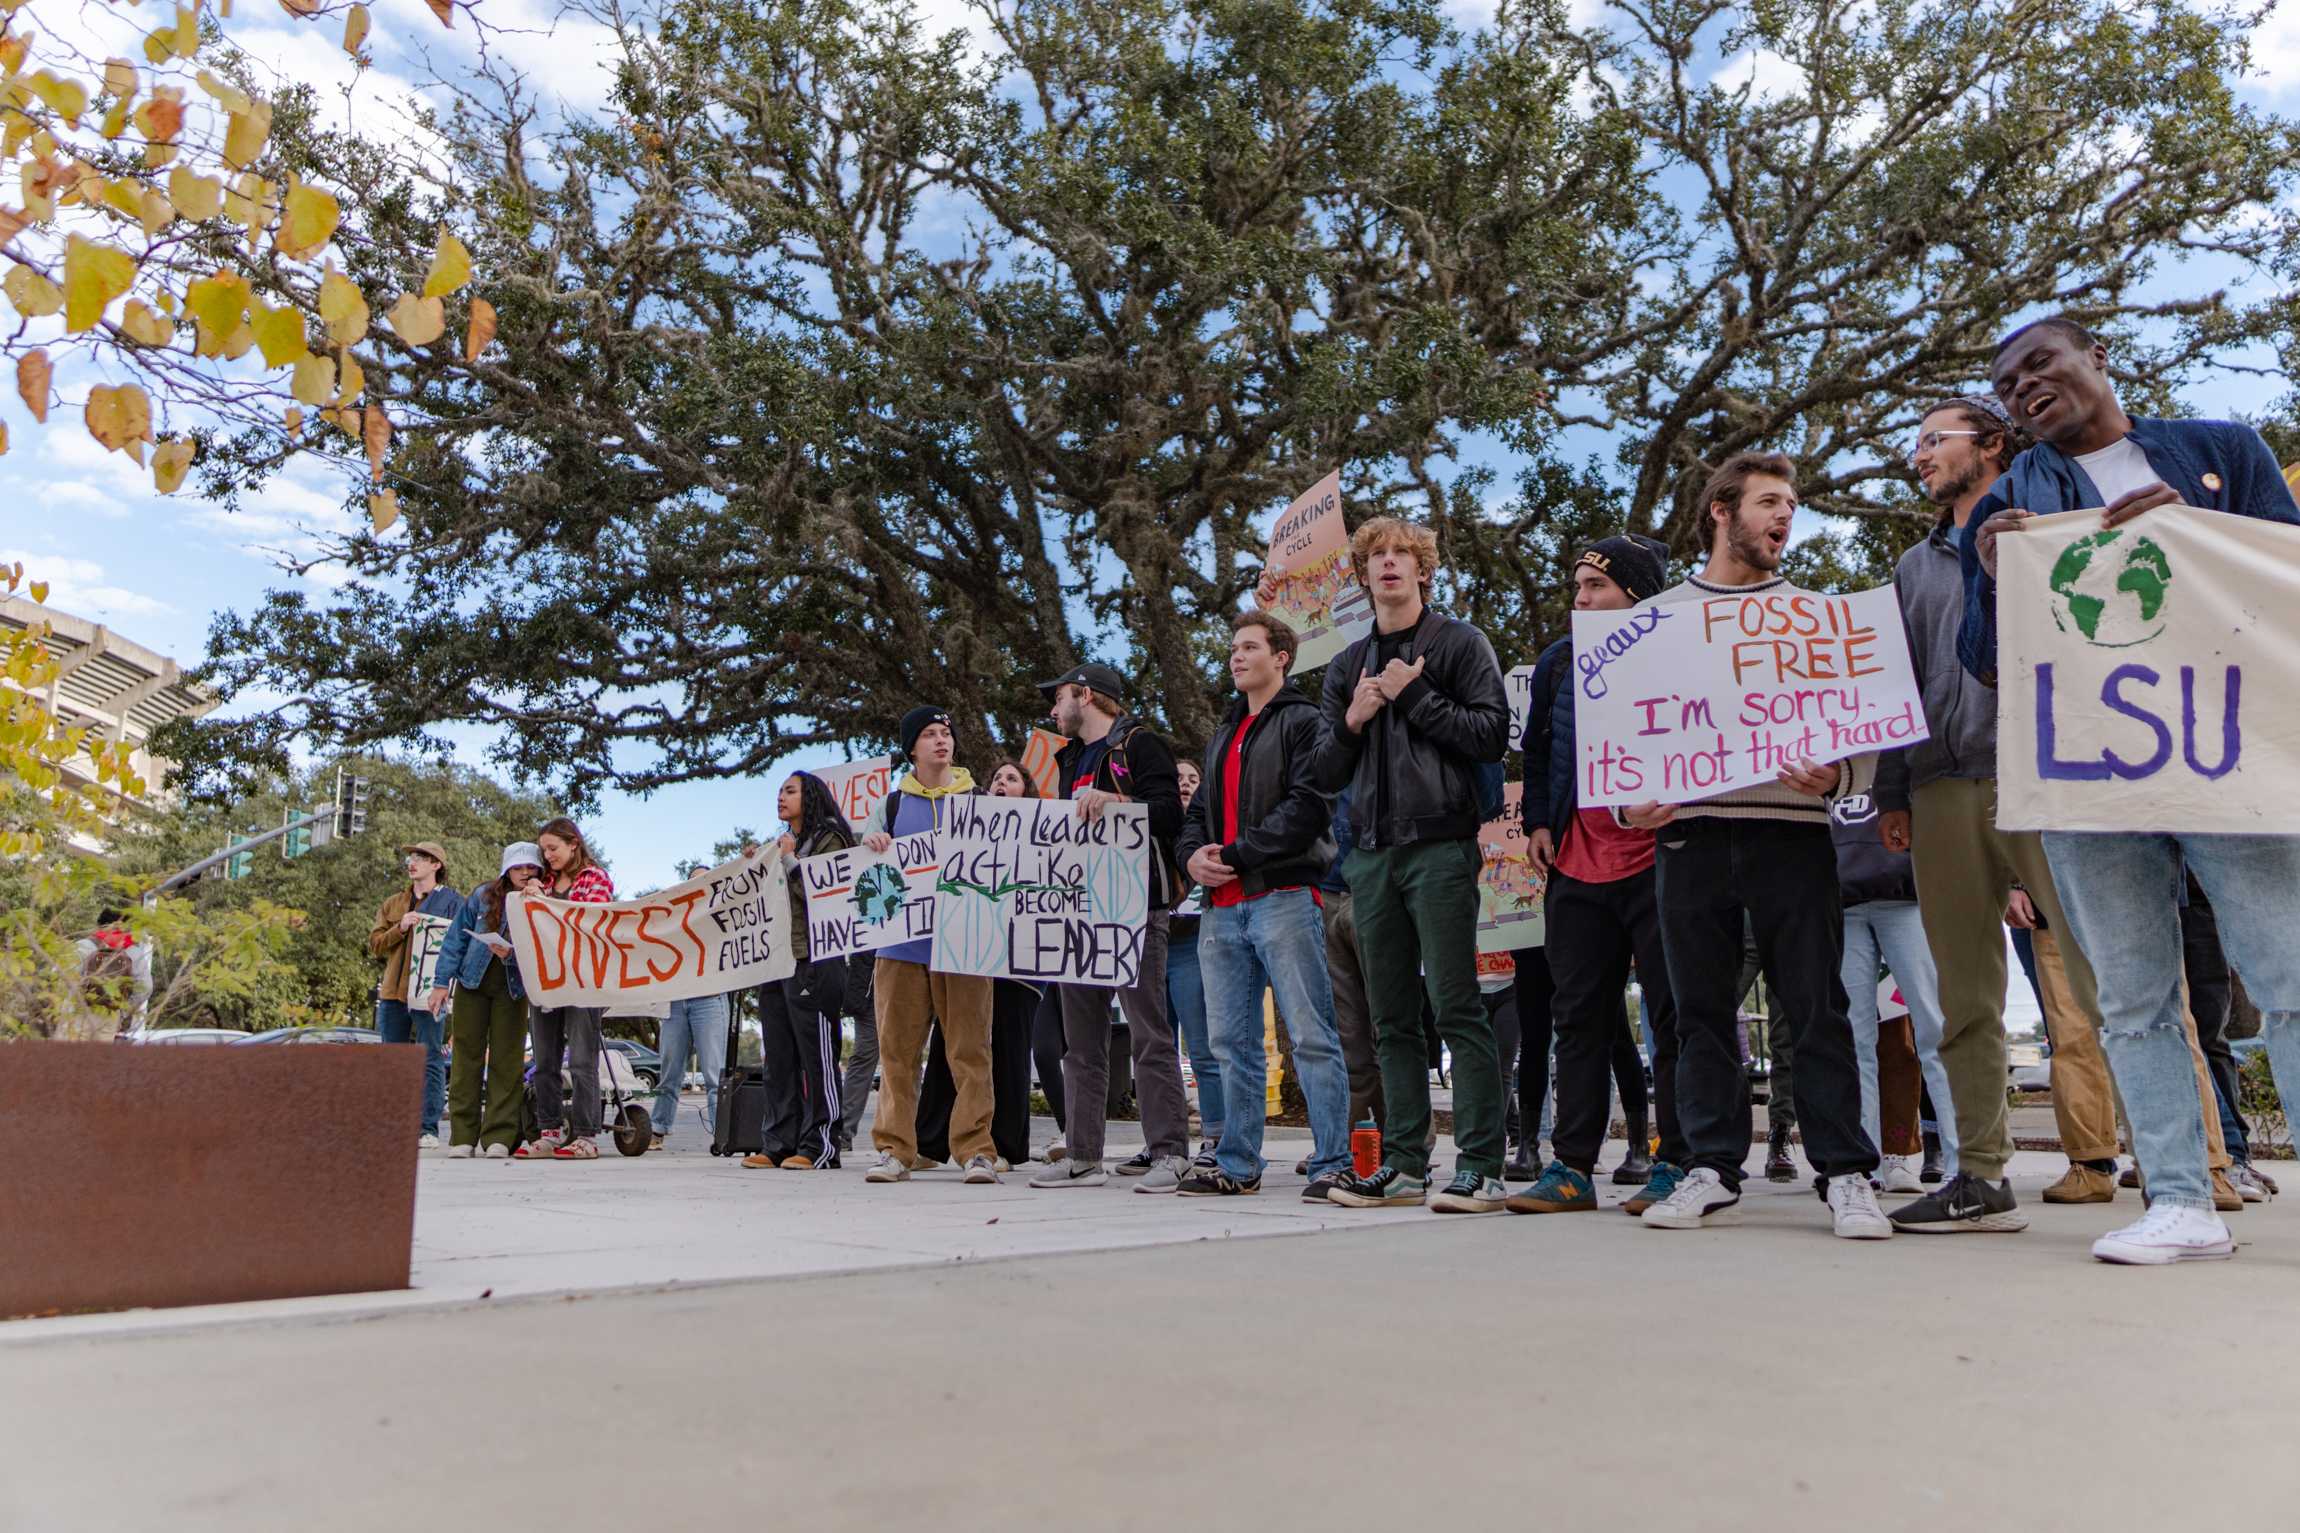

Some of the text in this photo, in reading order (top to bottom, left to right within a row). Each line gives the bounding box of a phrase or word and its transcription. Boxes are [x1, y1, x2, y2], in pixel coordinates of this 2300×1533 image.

[1273, 493, 1335, 549] BREAKING
[1286, 532, 1313, 556] CYCLE
[1703, 595, 1875, 643] FOSSIL
[1577, 606, 1674, 700] geaux
[1732, 635, 1884, 686] FREE
[1633, 694, 1717, 736] I'm
[2035, 662, 2241, 781] LSU
[1587, 739, 1643, 797] it's
[1664, 733, 1734, 791] not
[1746, 725, 1819, 774] that
[827, 767, 891, 820] VEST
[951, 795, 1022, 843] When
[1506, 828, 1522, 840] CY
[709, 863, 768, 908] FROM
[808, 853, 852, 890] WE
[943, 841, 1006, 896] act
[1086, 847, 1148, 924] KIDS
[525, 889, 706, 991] DIVEST
[718, 929, 770, 971] FUELS
[811, 896, 936, 957] HAVE TI
[937, 889, 1091, 976] KIDS BECOME
[1008, 917, 1147, 986] LEADERS
